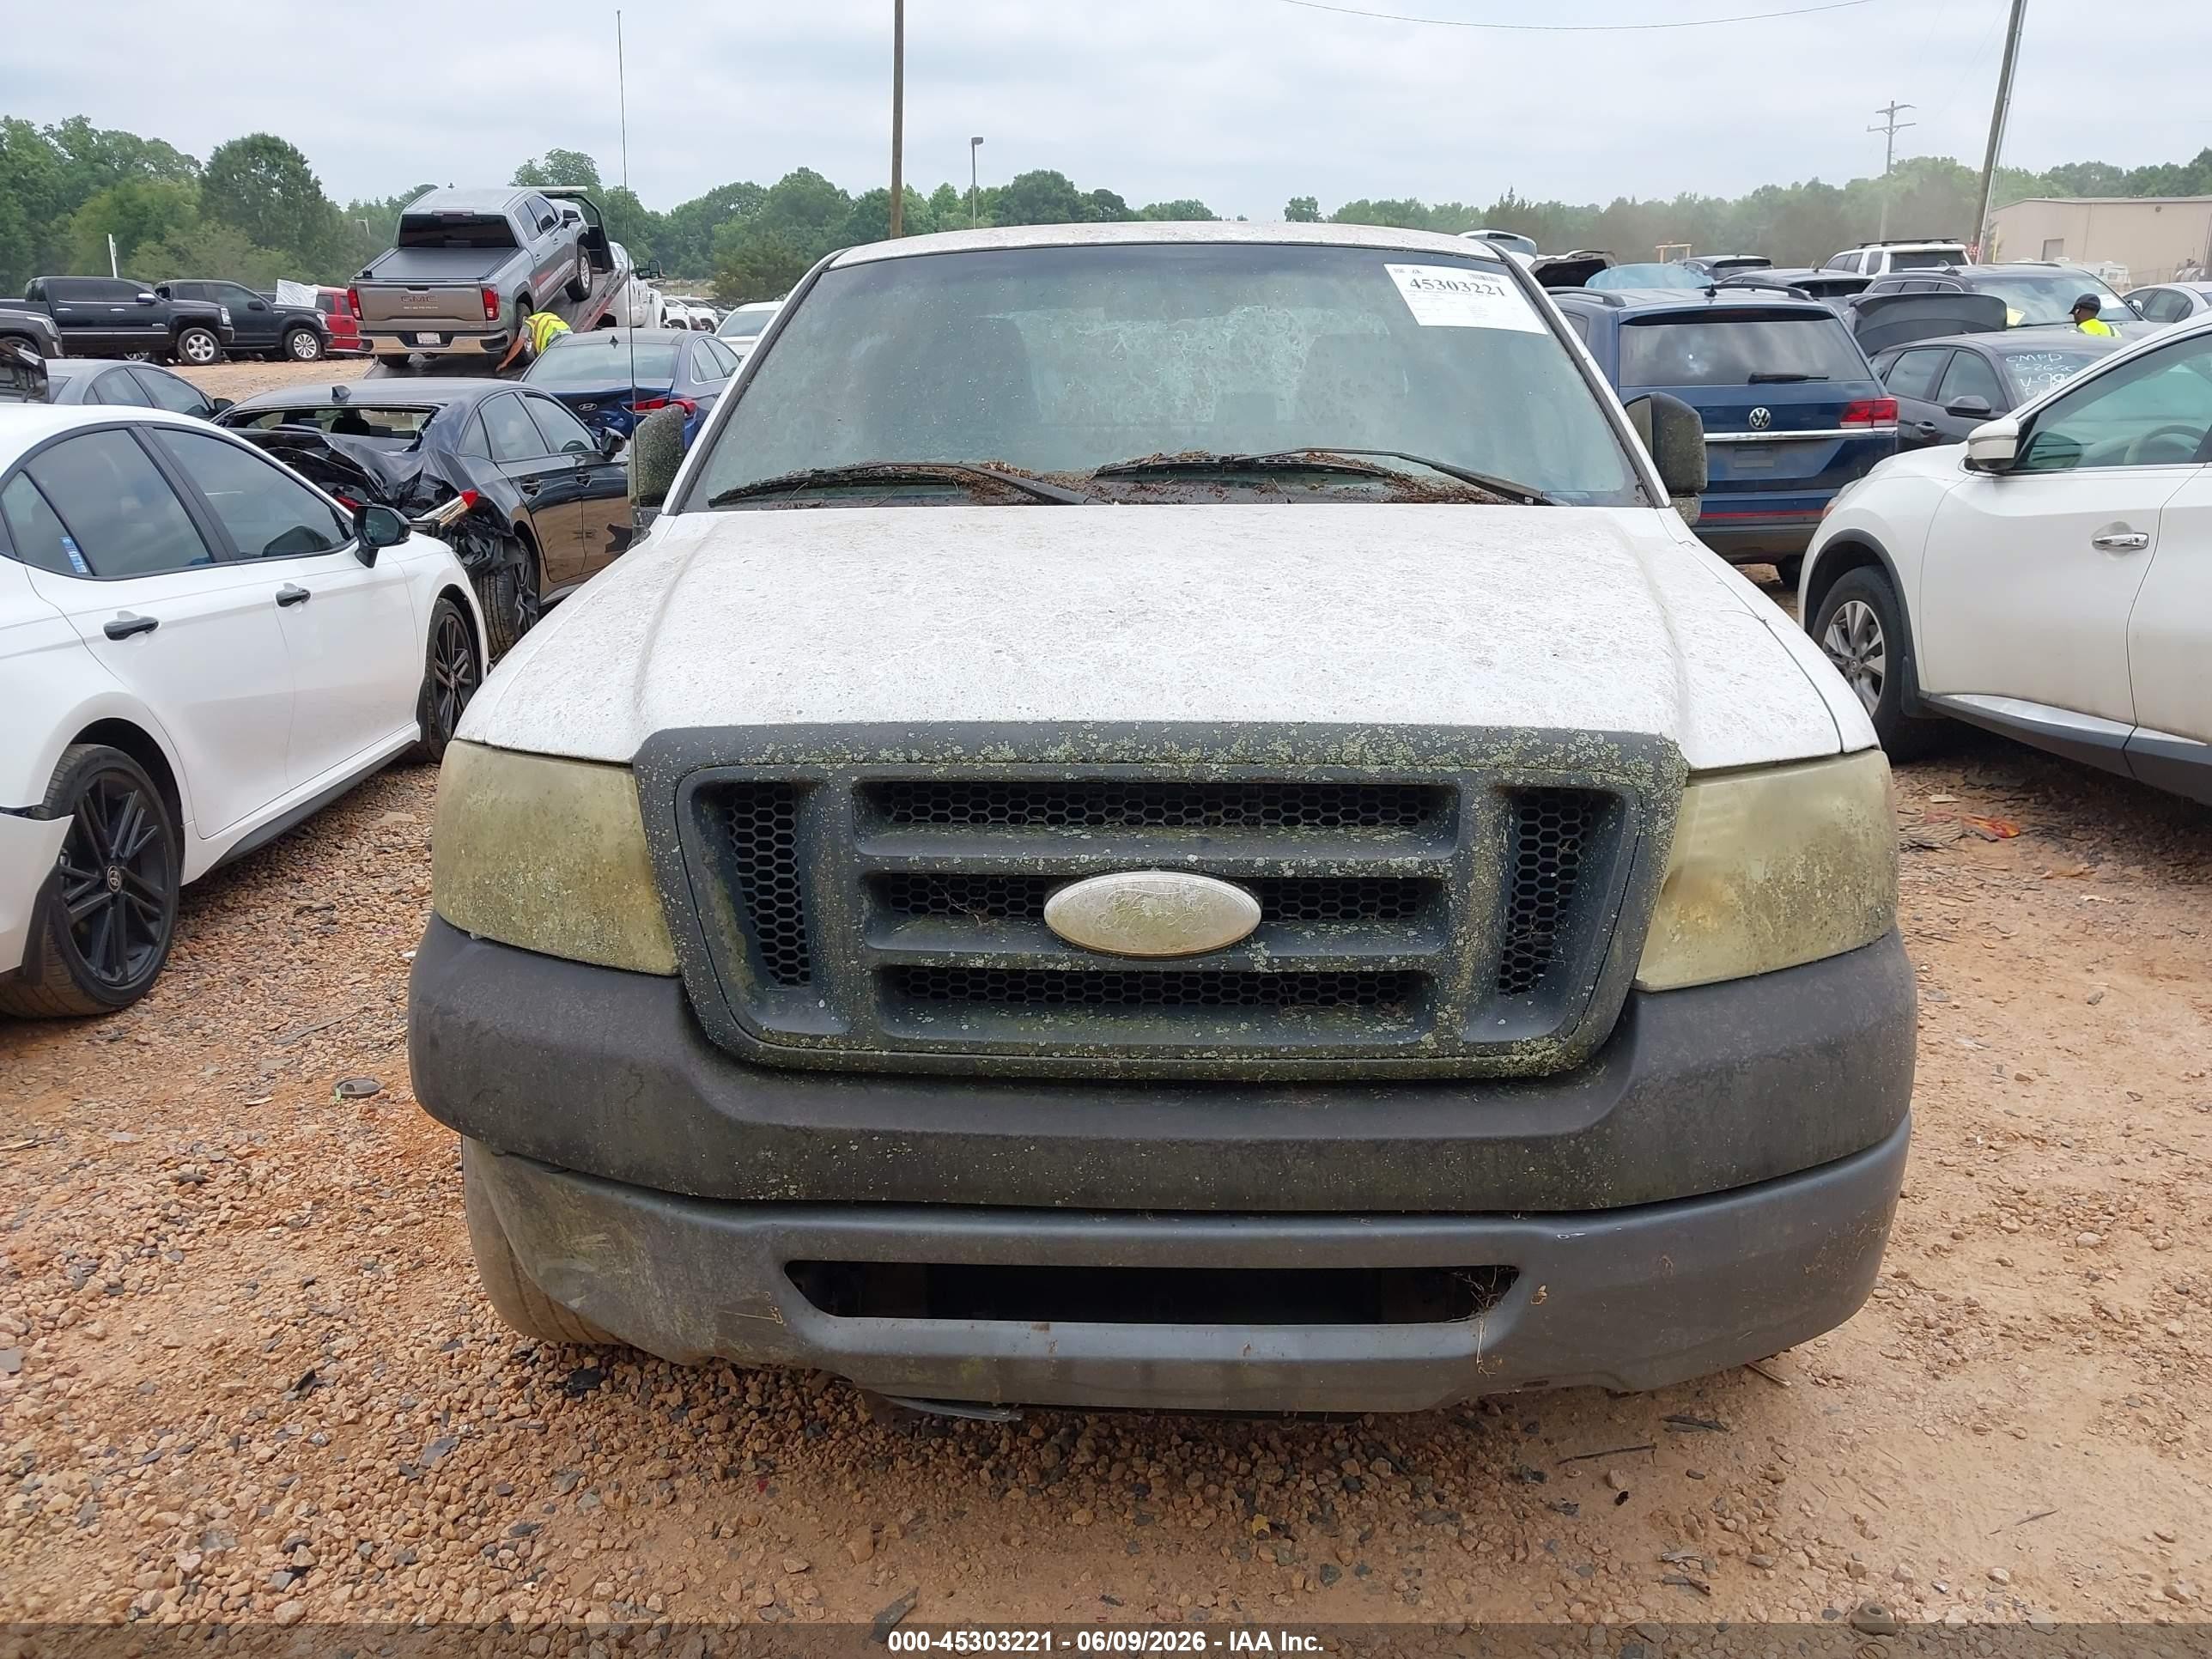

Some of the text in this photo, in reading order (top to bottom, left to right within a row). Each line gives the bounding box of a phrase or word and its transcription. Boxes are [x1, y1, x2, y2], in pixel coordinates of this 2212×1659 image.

[1410, 278, 1506, 296] 45303221
[401, 295, 438, 303] GMC
[2005, 353, 2063, 362] CMPD
